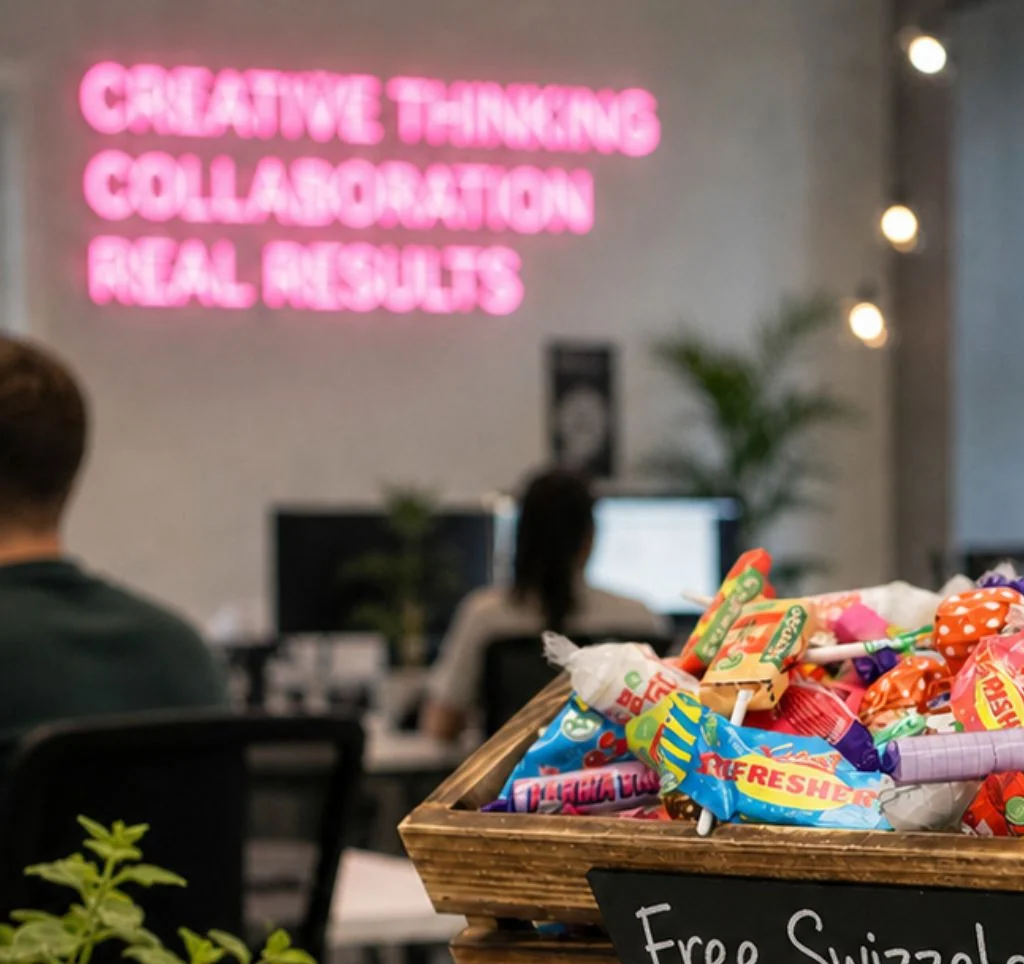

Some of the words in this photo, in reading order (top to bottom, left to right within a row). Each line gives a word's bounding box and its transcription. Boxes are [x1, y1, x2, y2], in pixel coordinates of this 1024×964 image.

[80, 61, 384, 144] CREATIVE
[388, 76, 661, 157] THINKING
[83, 149, 595, 234] COLLABORATION
[87, 235, 256, 308] REAL
[262, 240, 524, 315] RESULTS
